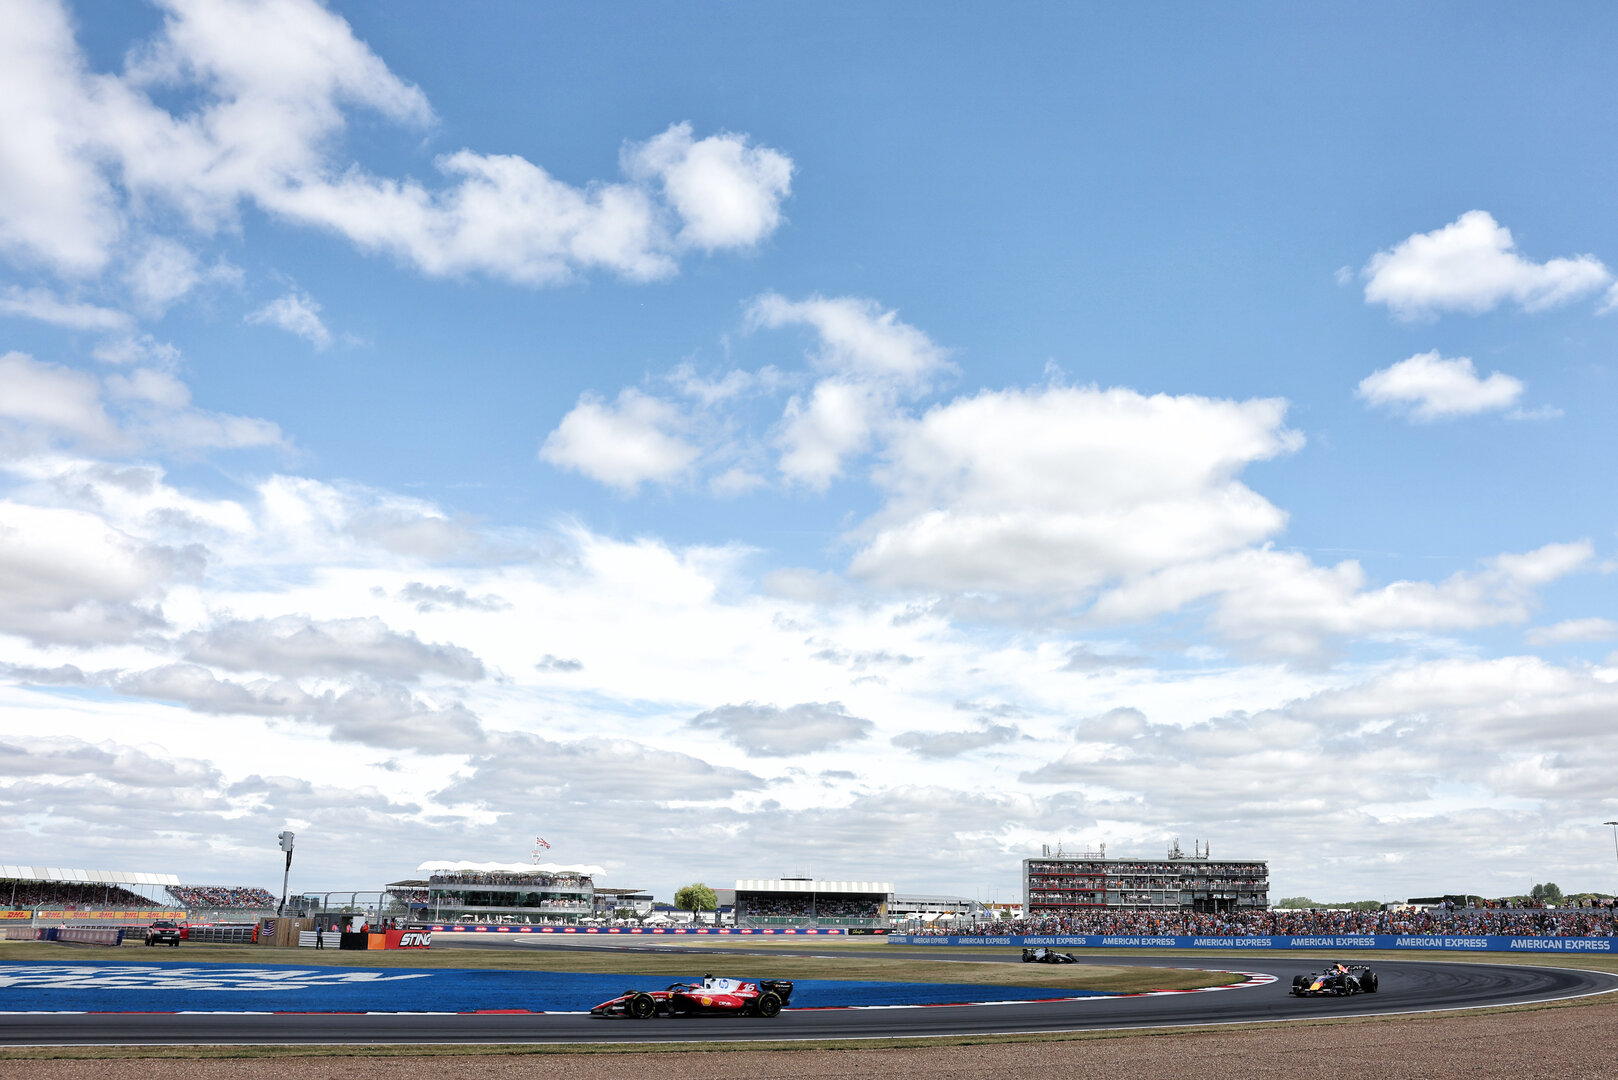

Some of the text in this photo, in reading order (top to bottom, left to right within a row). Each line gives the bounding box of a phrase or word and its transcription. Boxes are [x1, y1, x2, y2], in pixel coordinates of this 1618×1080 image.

[400, 933, 431, 946] STING
[958, 937, 1010, 945] AMERICAN EXPRESS
[1023, 937, 1086, 945] AMERICAN EXPRESS
[1102, 937, 1175, 946] AMERICAN EXPRESS
[1193, 938, 1272, 946] AMERICAN EXPRESS
[1290, 937, 1375, 946] AMERICAN EXPRESS
[1395, 938, 1488, 948] AMERICAN EXPRESS
[1510, 939, 1610, 950] AMERICAN EXPRESS
[743, 983, 756, 991] 16
